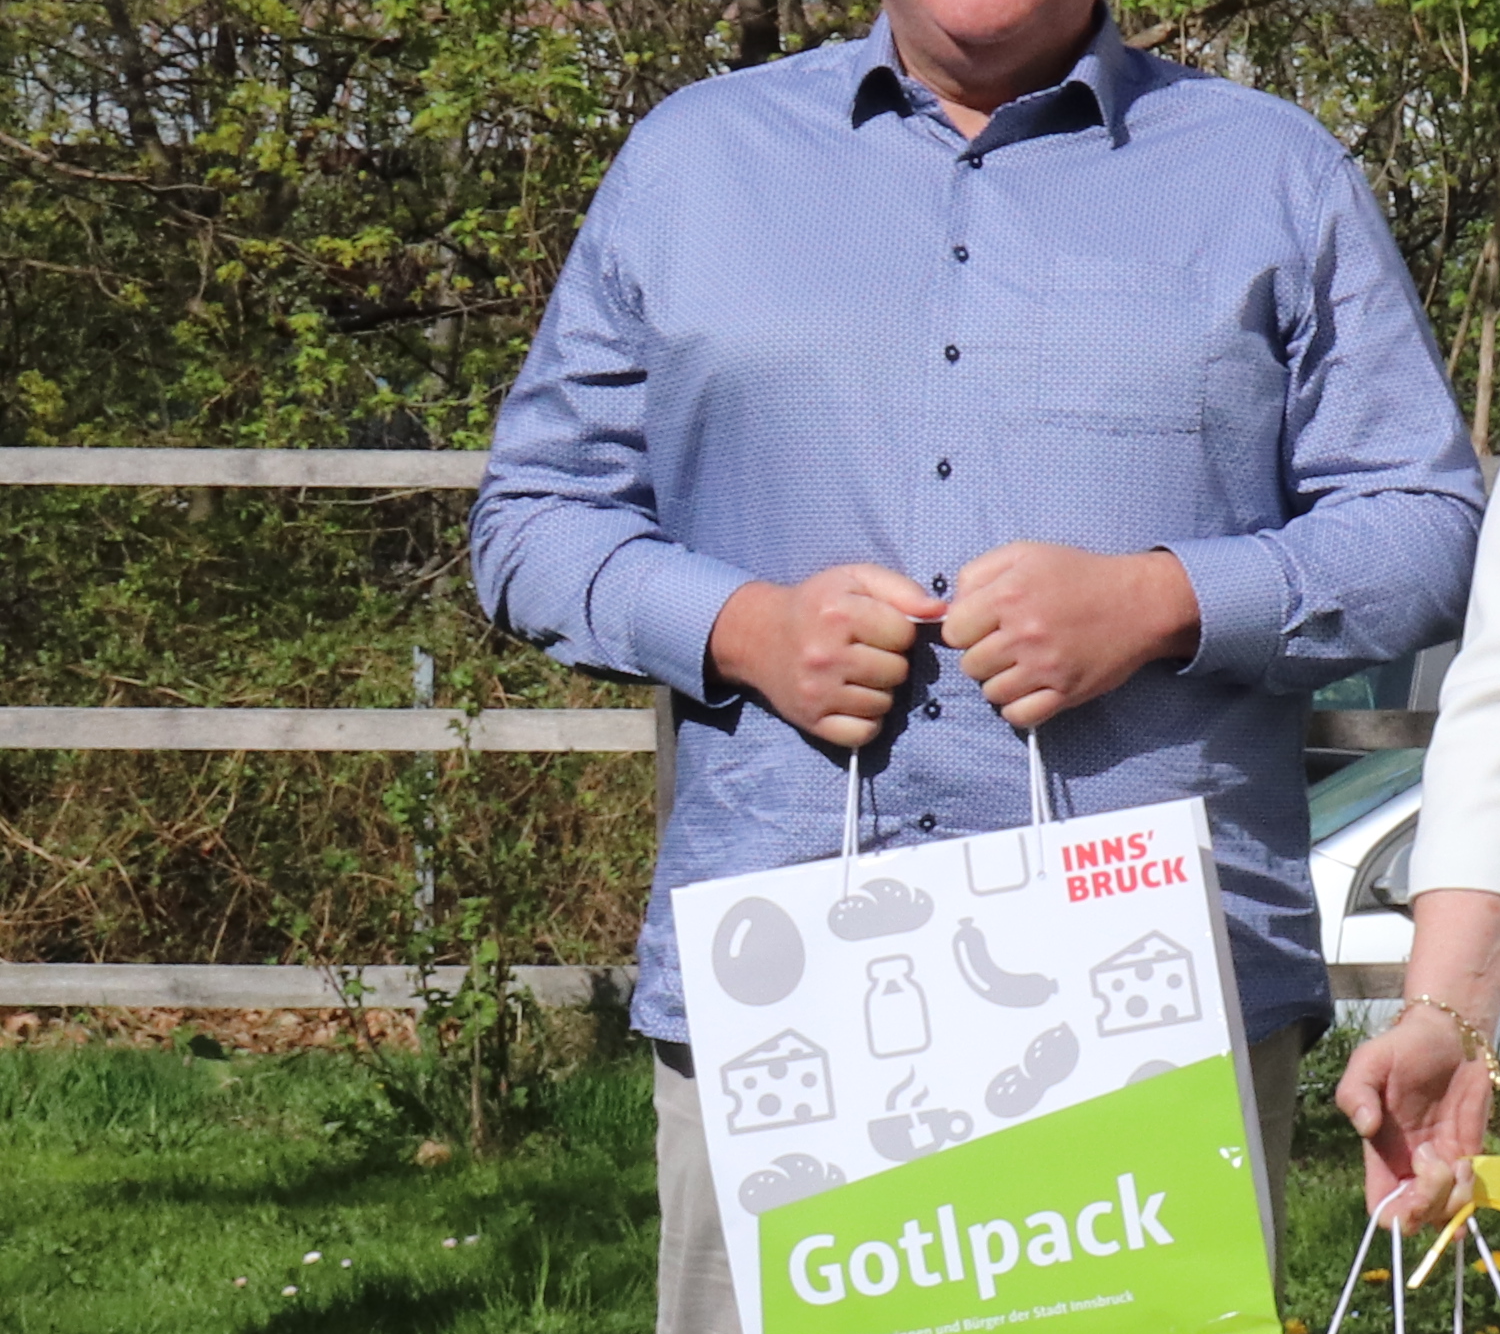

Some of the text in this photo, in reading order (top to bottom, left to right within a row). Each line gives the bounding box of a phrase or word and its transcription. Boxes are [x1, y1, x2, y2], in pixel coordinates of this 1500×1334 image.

[1066, 855, 1188, 903] BRUCK
[788, 1172, 1175, 1305] Gotlpack
[963, 1313, 1006, 1333] Bürger
[1008, 1308, 1030, 1324] der
[1033, 1302, 1068, 1319] Stadt
[1070, 1290, 1135, 1313] Innsbruck
